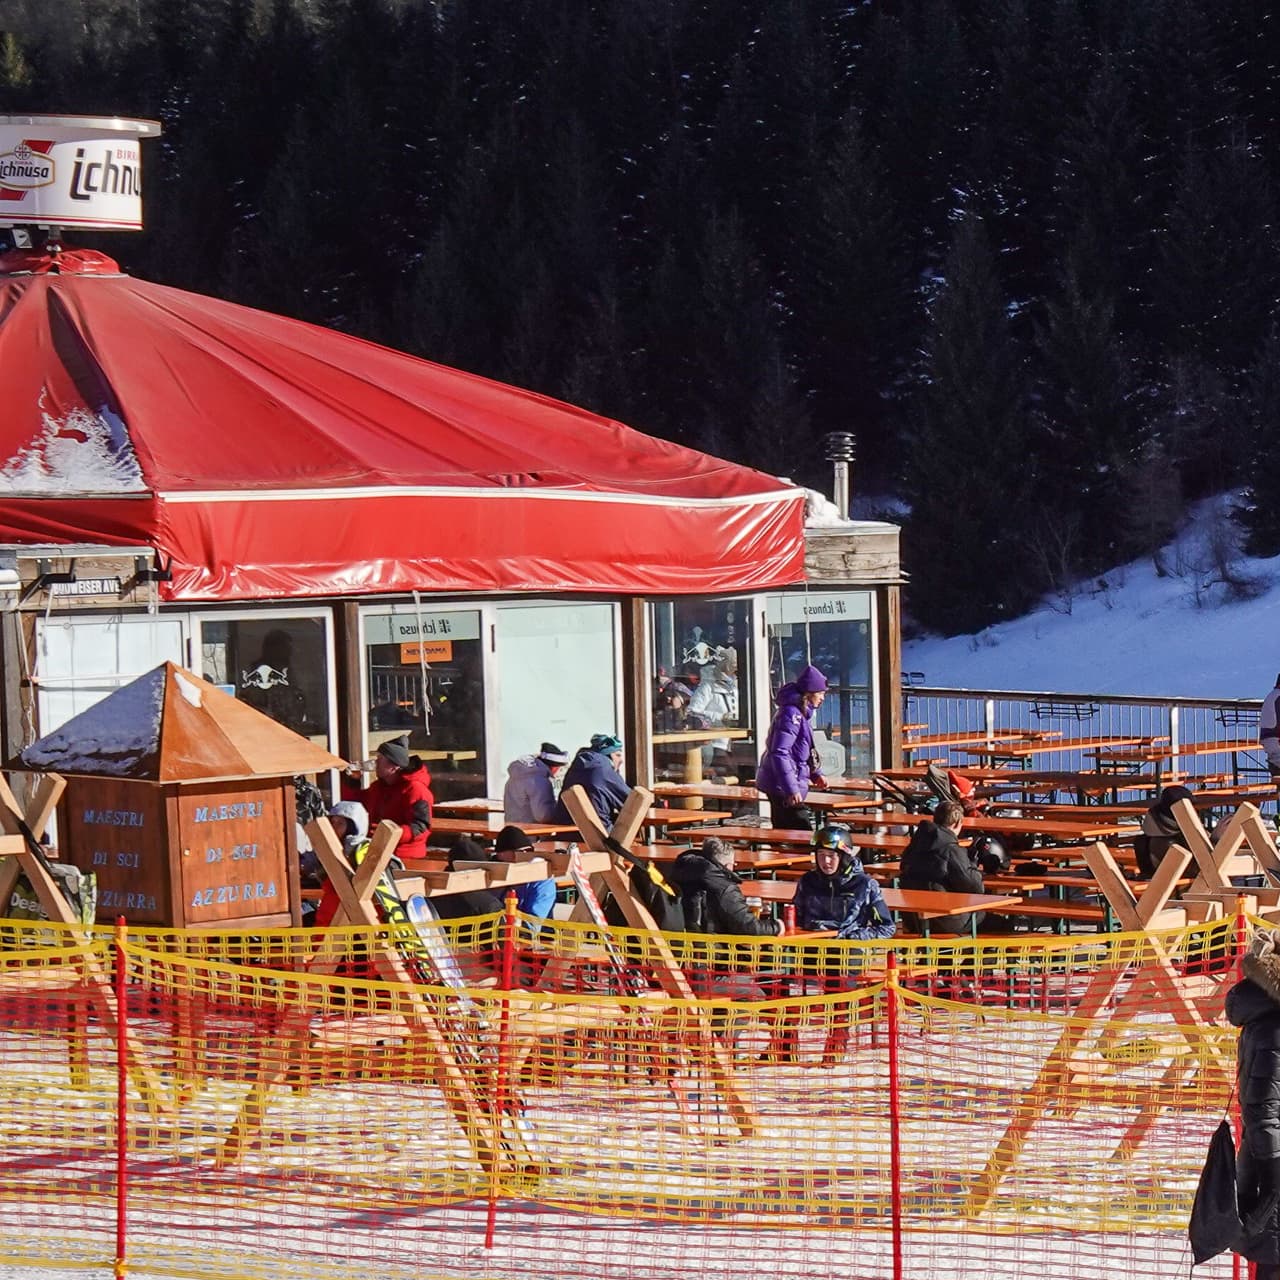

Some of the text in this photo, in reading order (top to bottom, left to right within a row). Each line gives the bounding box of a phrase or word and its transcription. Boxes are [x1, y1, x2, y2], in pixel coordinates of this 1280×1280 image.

[84, 810, 144, 827] MAESTRI
[194, 801, 263, 823] MAESTRI
[93, 852, 140, 868] DI SCI
[206, 844, 258, 863] DI SCI
[98, 890, 156, 910] ZURRA
[192, 881, 277, 907] AZZURRA
